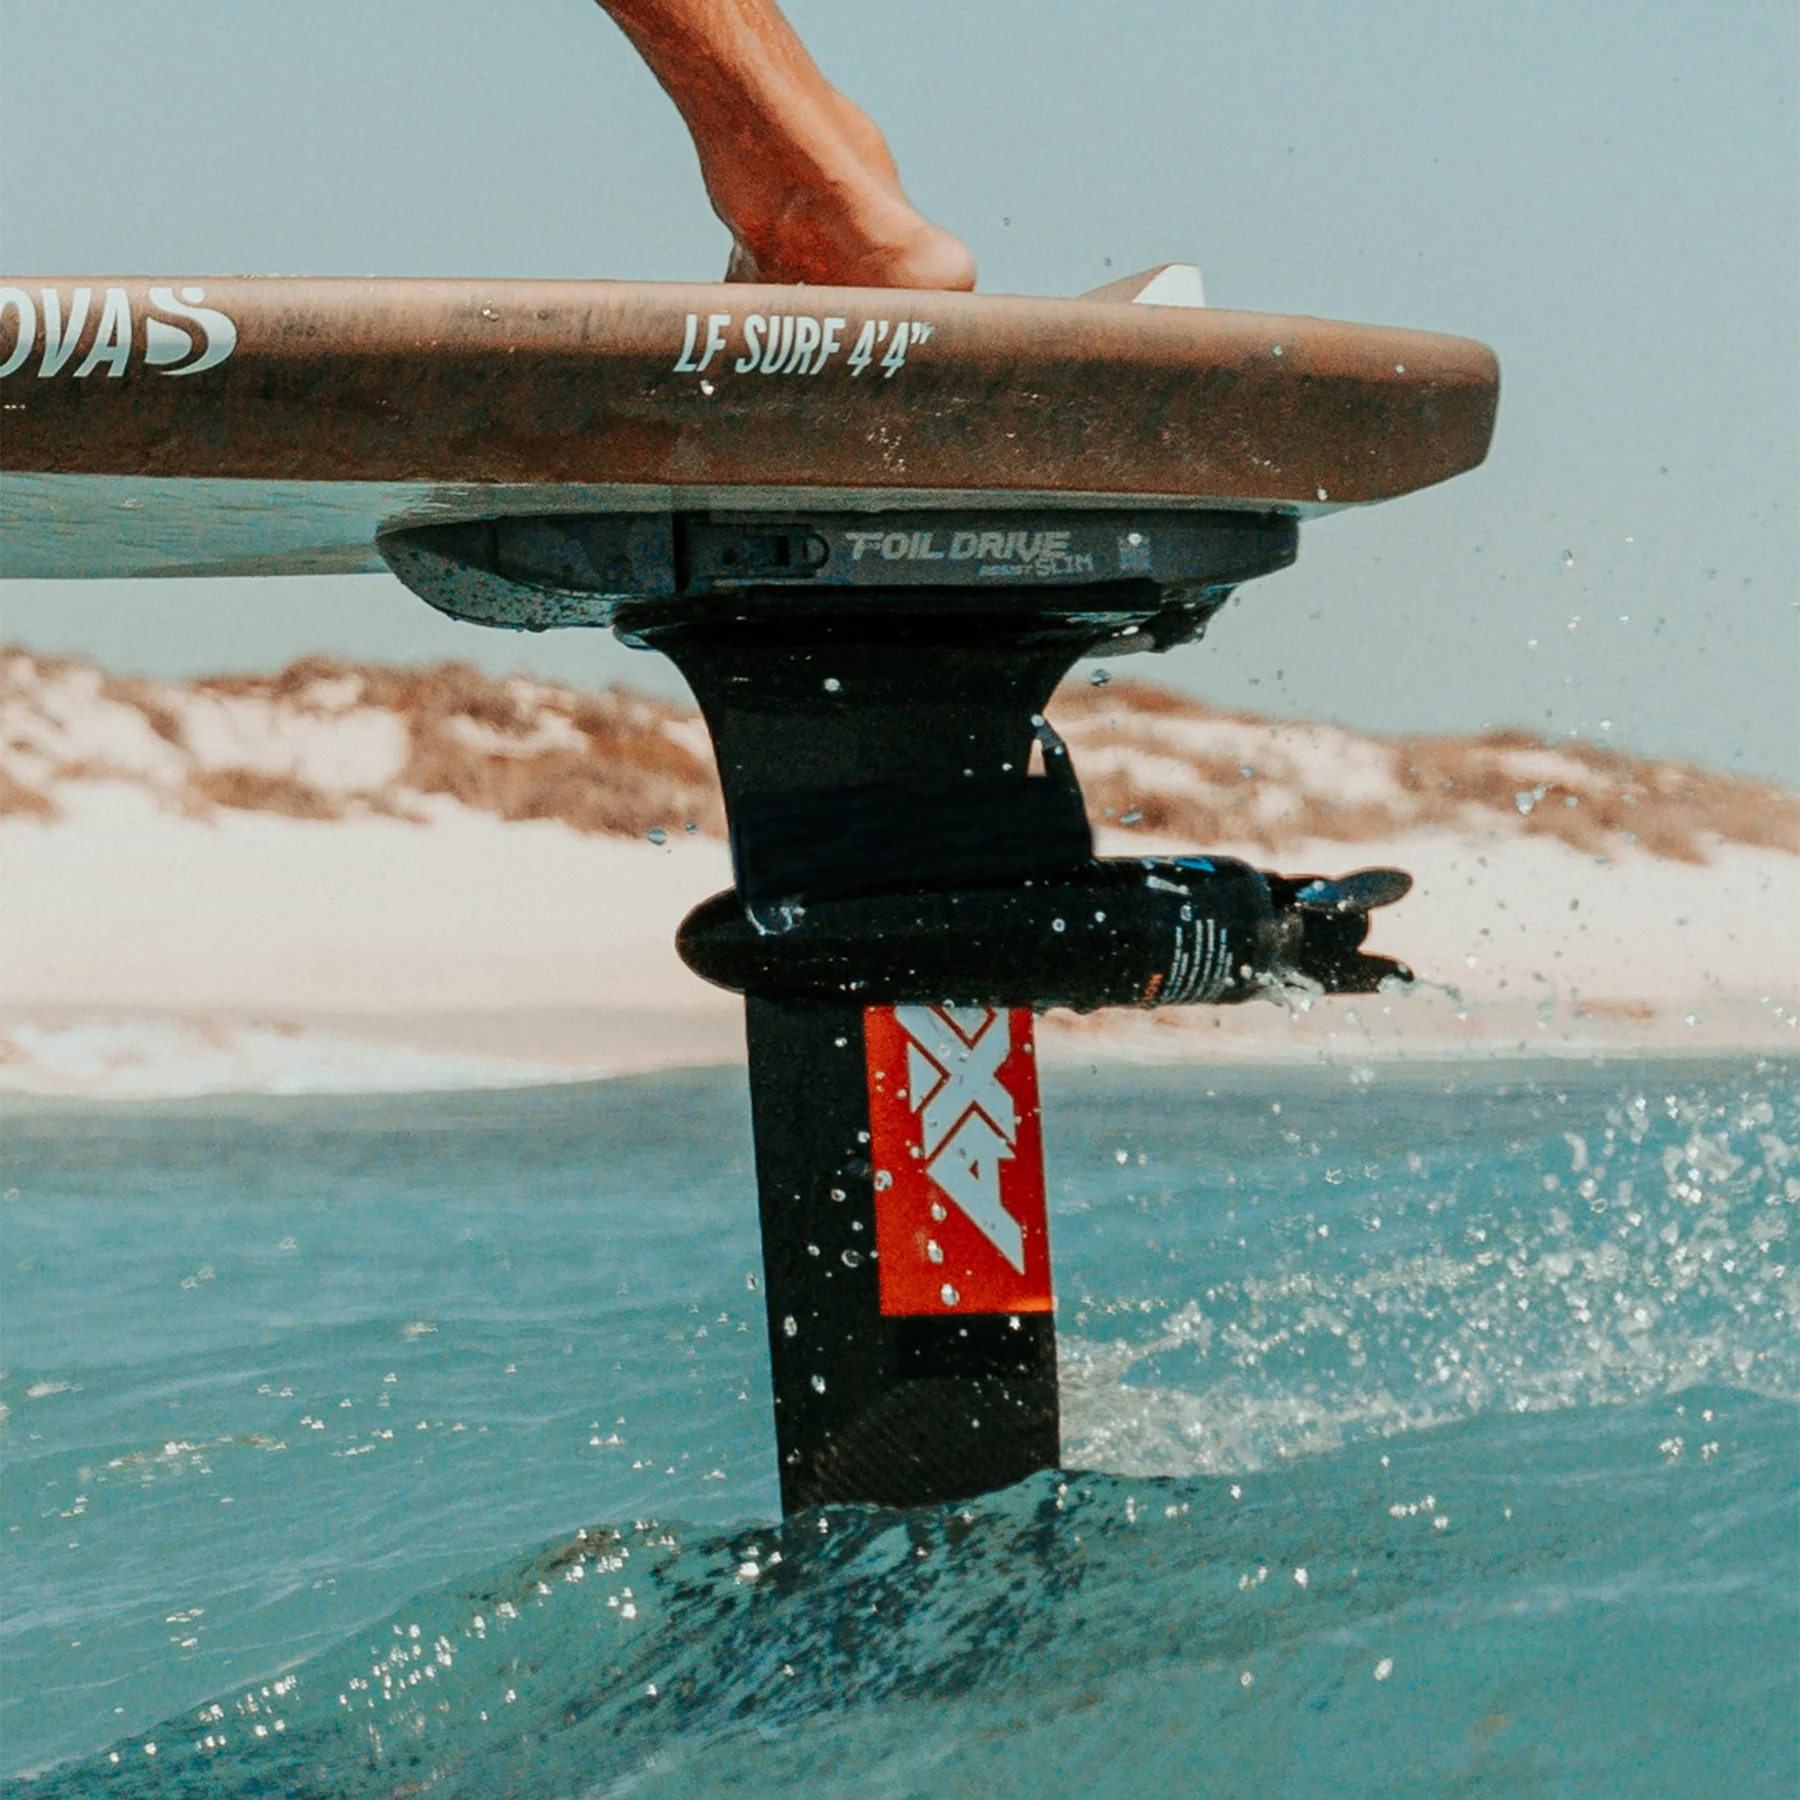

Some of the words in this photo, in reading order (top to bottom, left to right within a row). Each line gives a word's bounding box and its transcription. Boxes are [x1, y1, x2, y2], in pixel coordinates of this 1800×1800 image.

[673, 313, 731, 372] LF
[734, 314, 846, 375] SURF
[845, 531, 944, 560] FOIL
[950, 531, 1071, 562] DRIVE
